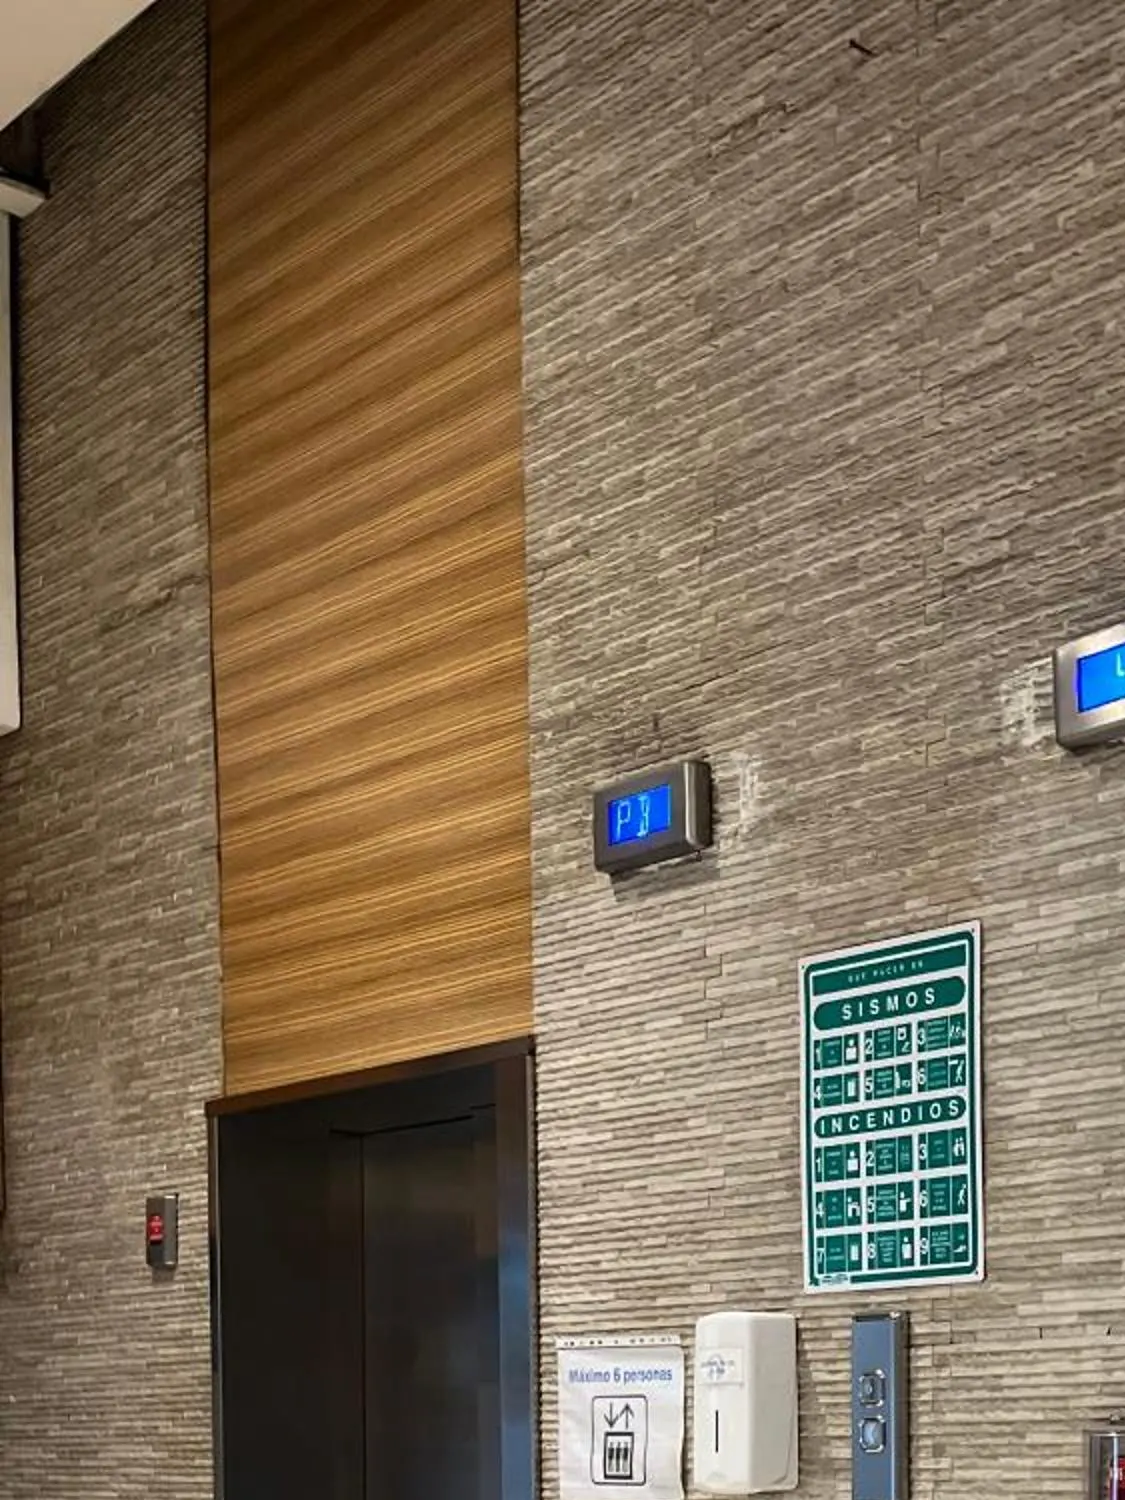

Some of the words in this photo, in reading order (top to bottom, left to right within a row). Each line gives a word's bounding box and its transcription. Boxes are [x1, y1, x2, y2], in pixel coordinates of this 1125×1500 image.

[841, 987, 936, 1021] SISMOS
[820, 1099, 960, 1135] INCENDIOS
[569, 1367, 610, 1383] Máximo
[613, 1367, 621, 1383] 6
[623, 1369, 673, 1386] personas
